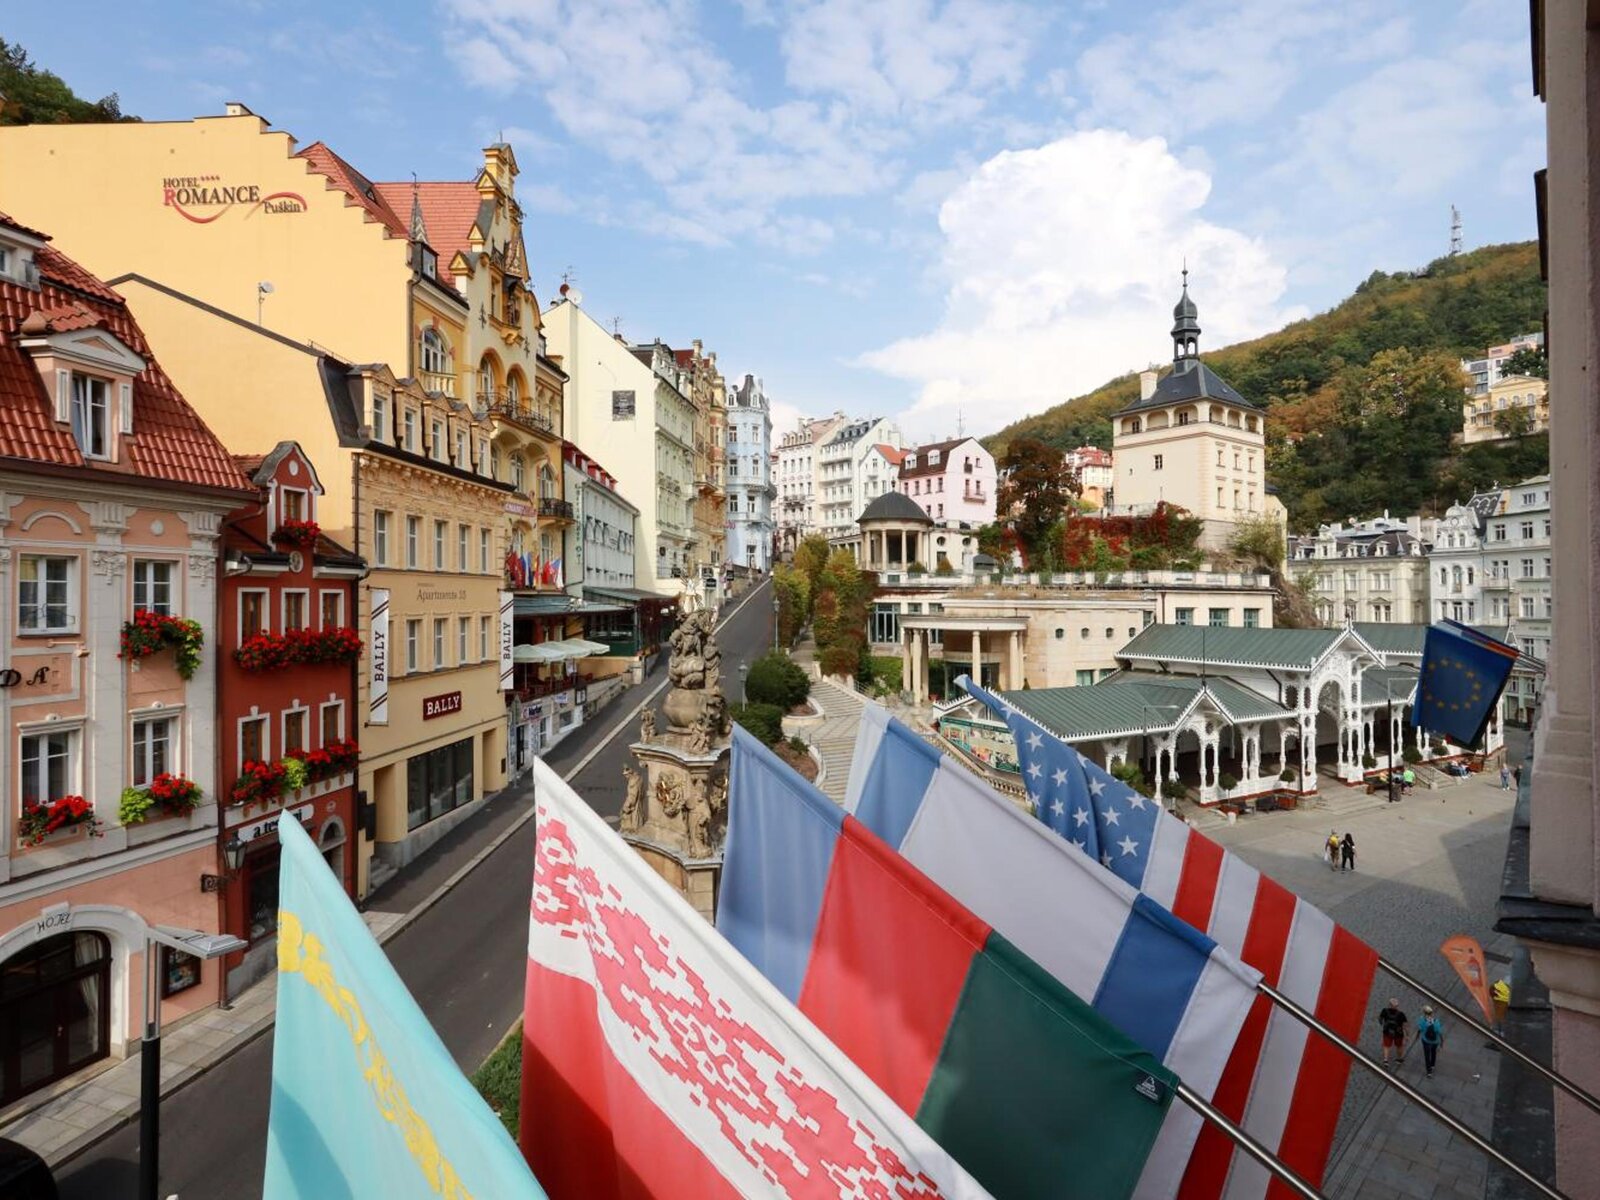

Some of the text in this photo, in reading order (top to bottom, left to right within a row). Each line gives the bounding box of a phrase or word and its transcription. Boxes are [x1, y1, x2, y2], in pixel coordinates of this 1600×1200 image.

[163, 177, 200, 188] HOTEL
[163, 185, 301, 214] ROMANCE Puškin
[503, 622, 511, 660] BALLY
[374, 630, 385, 682] BALLY
[427, 695, 460, 715] BALLY
[37, 911, 71, 934] HOTEL
